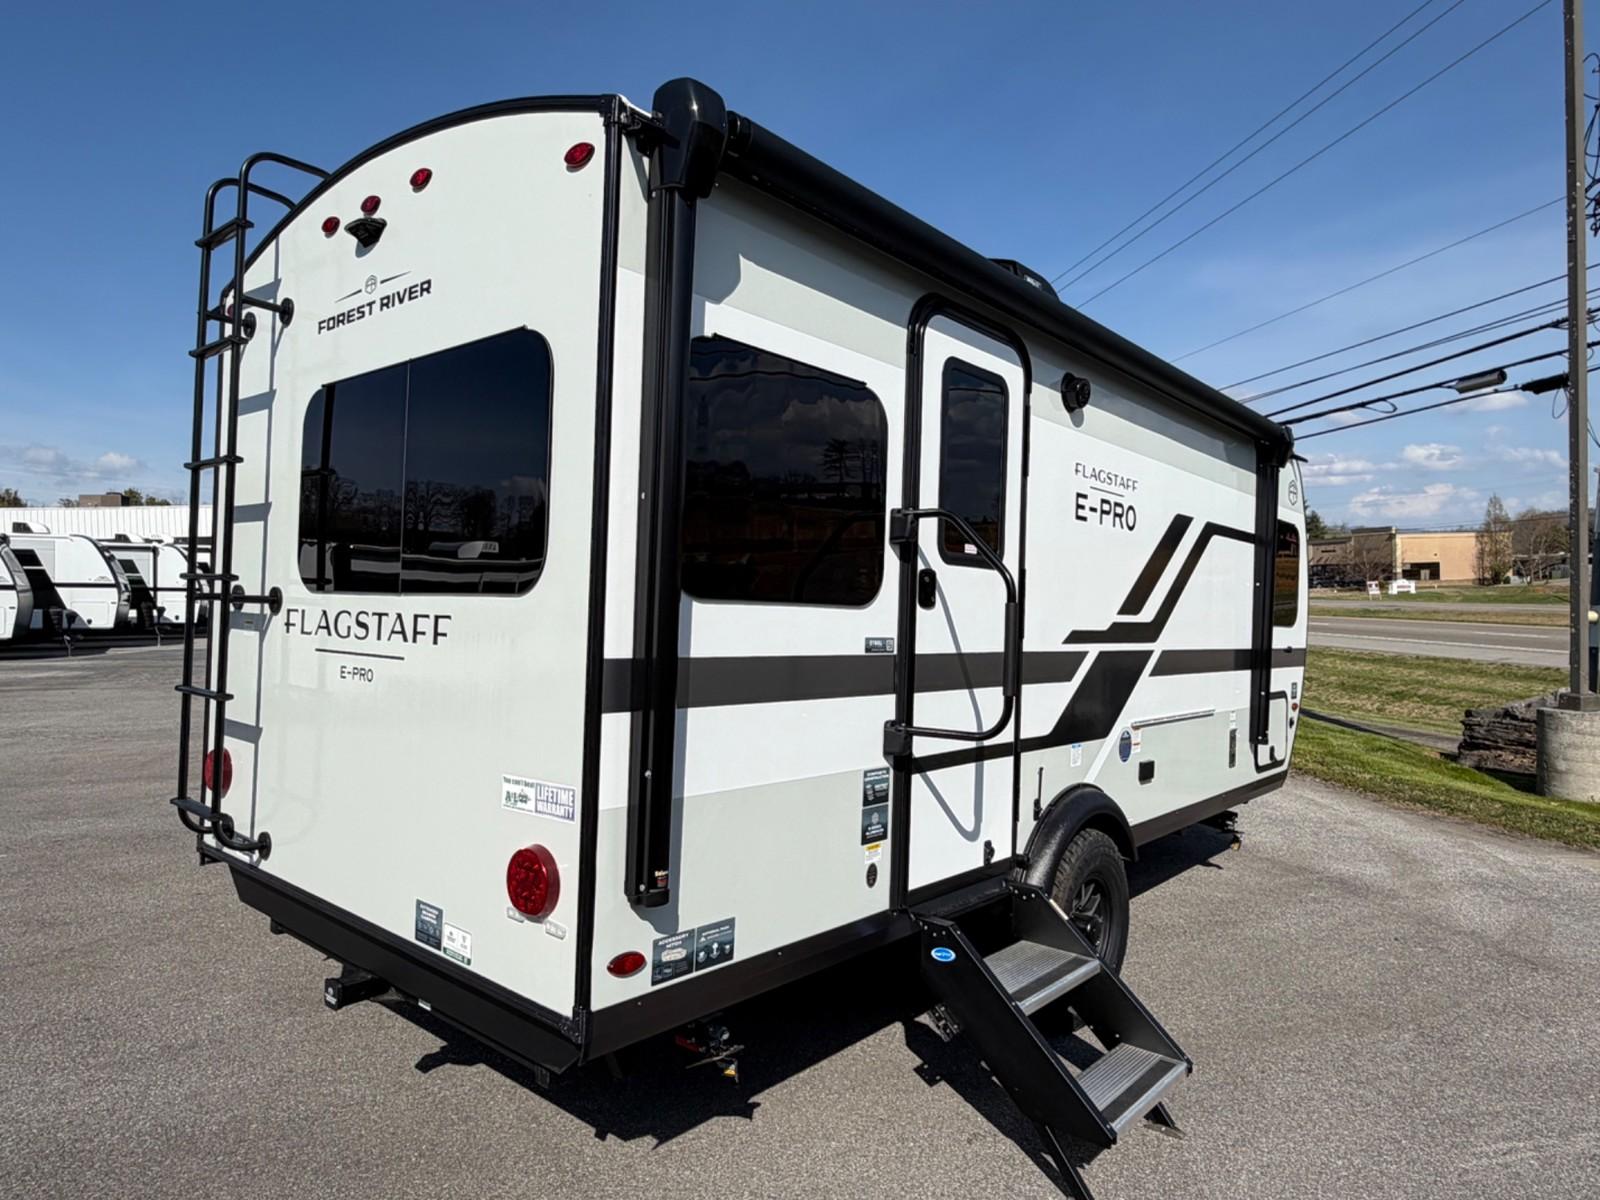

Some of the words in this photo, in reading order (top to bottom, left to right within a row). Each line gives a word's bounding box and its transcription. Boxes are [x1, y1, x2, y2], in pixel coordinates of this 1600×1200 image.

[318, 300, 376, 335] FOREST
[380, 279, 432, 311] RIVER
[1075, 462, 1139, 491] FLAGSTAFF
[1075, 492, 1136, 531] E-PRO
[284, 609, 452, 645] FLAGSTAFF
[340, 666, 374, 682] E-PRO
